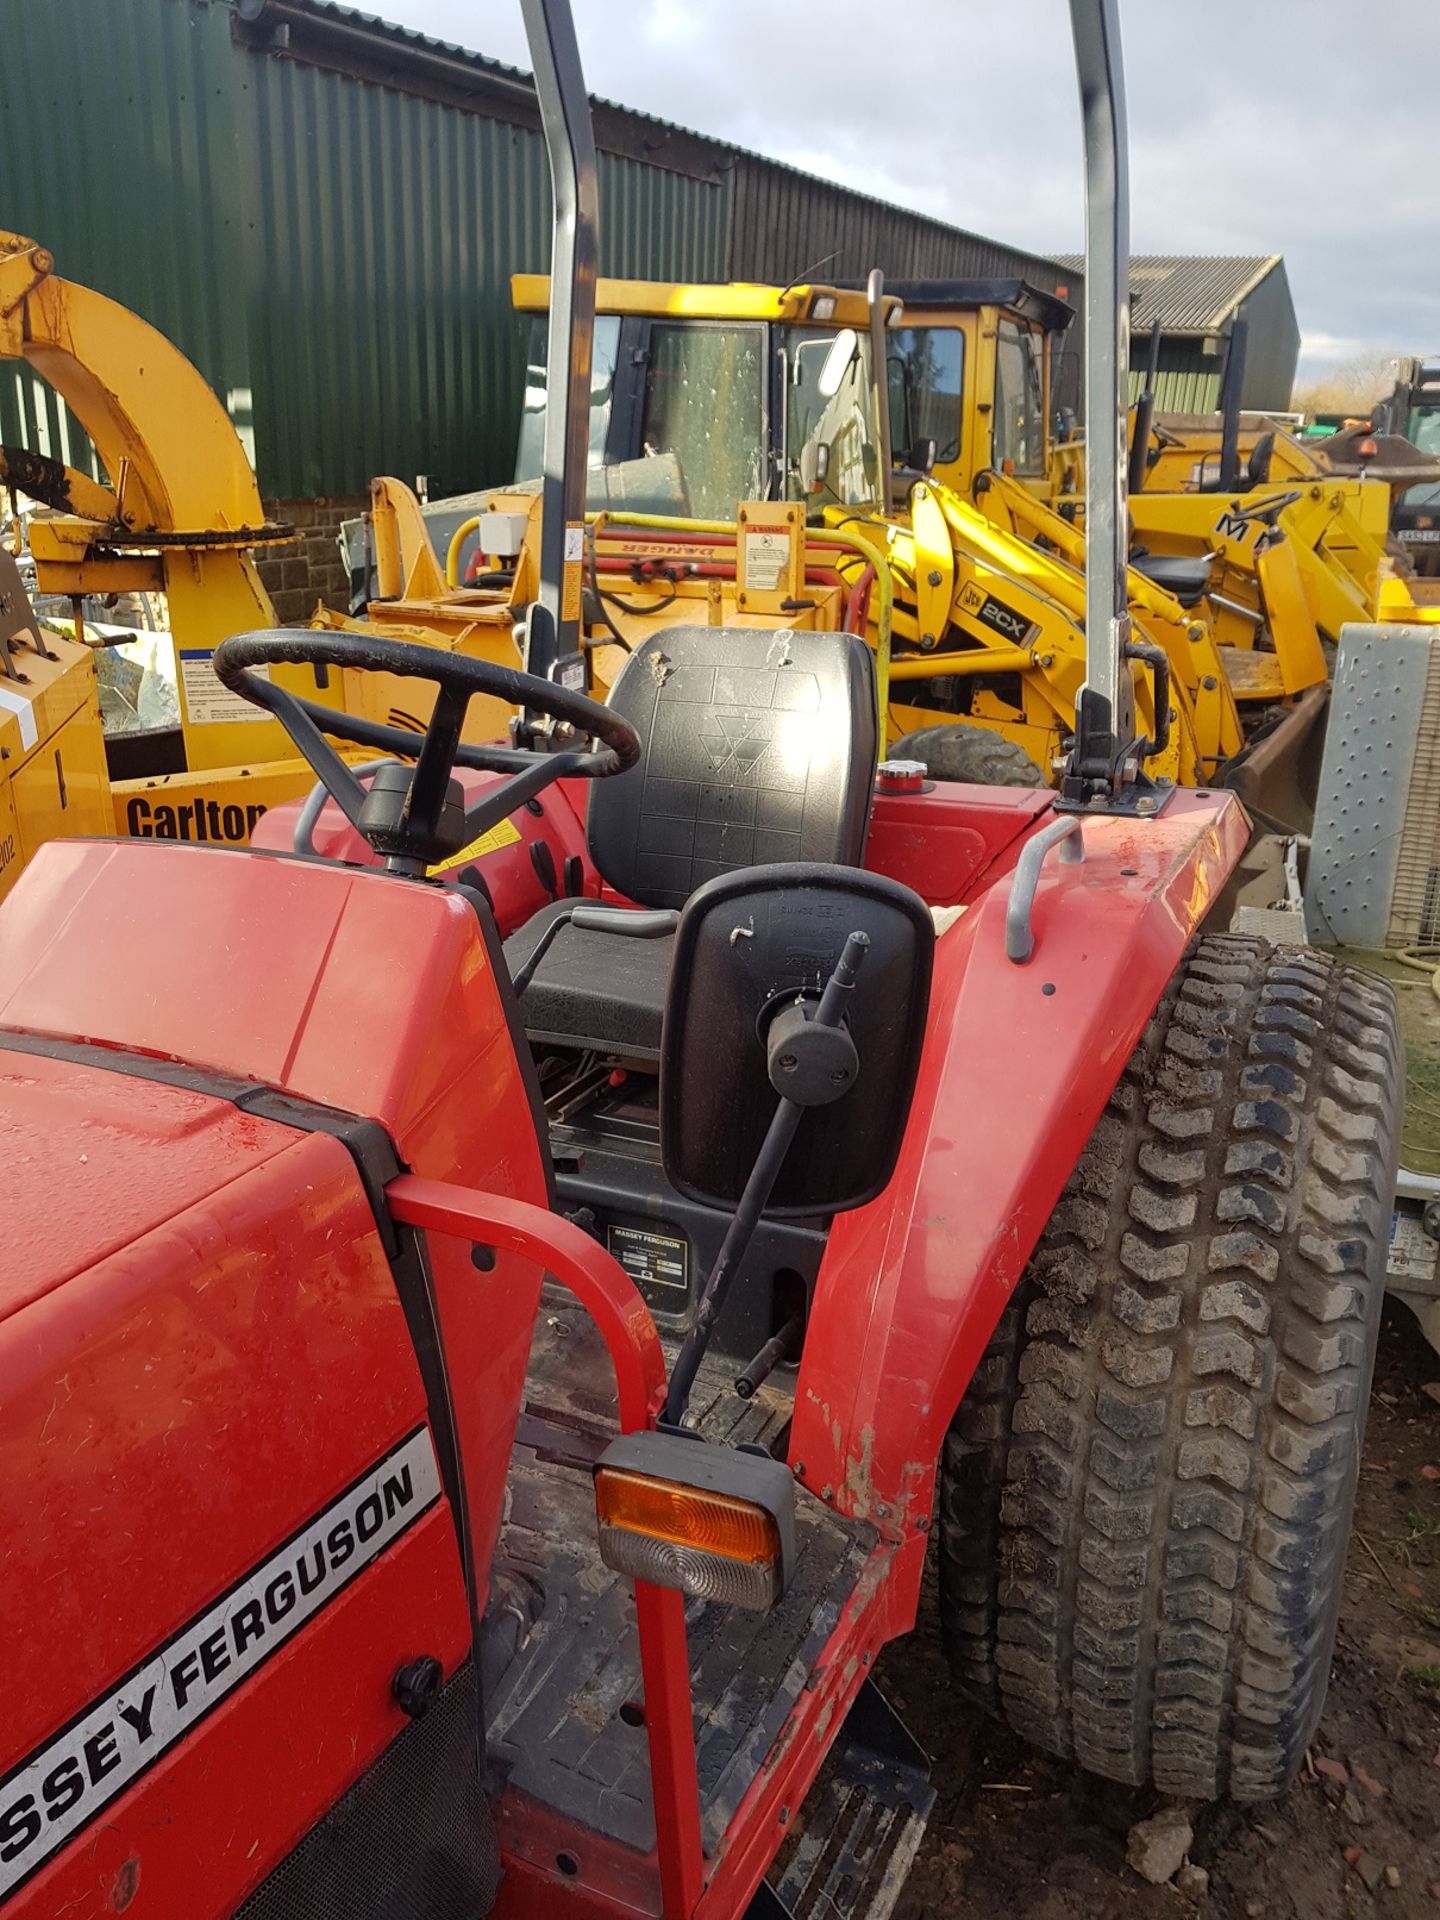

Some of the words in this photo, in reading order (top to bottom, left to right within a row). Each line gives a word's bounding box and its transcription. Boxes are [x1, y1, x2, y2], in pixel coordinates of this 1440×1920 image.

[621, 544, 715, 556] DANGER
[982, 602, 1025, 638] 2CX
[614, 1229, 642, 1240] MASSEY
[643, 1236, 681, 1248] FERGUSON
[170, 1463, 414, 1711] FERGUSON
